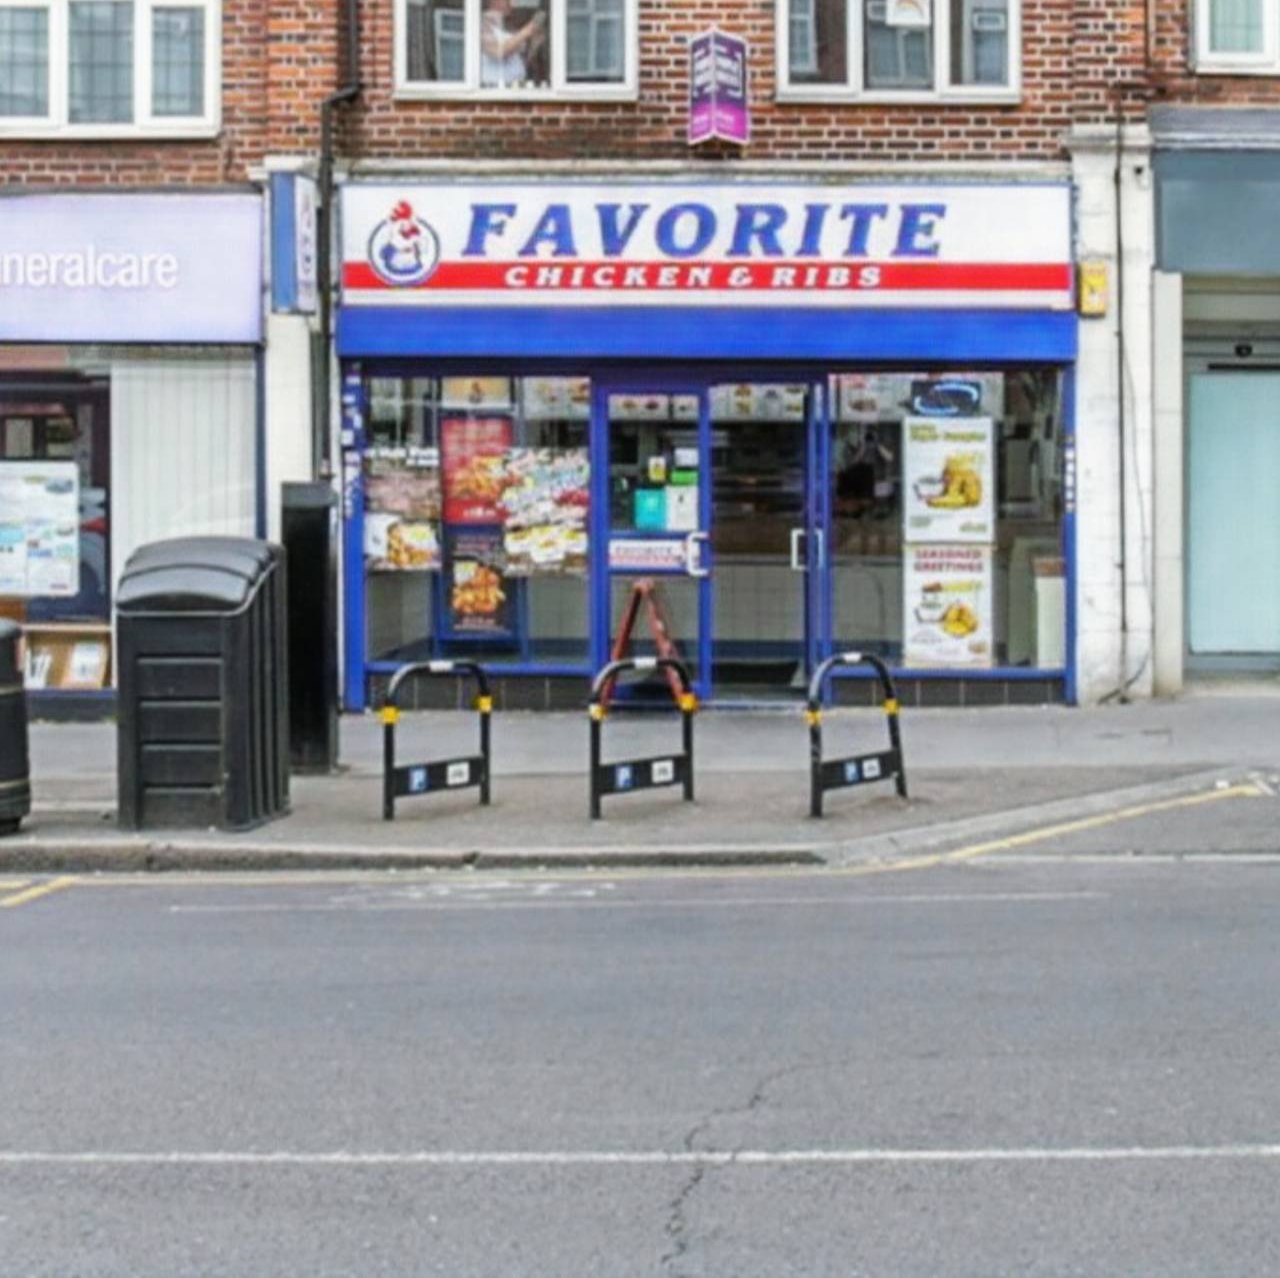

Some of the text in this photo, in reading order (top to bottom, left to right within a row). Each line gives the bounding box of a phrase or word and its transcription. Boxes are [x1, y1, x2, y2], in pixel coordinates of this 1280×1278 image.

[462, 203, 945, 258] FAVORITE
[504, 265, 882, 288] CHICKEN & RIBS
